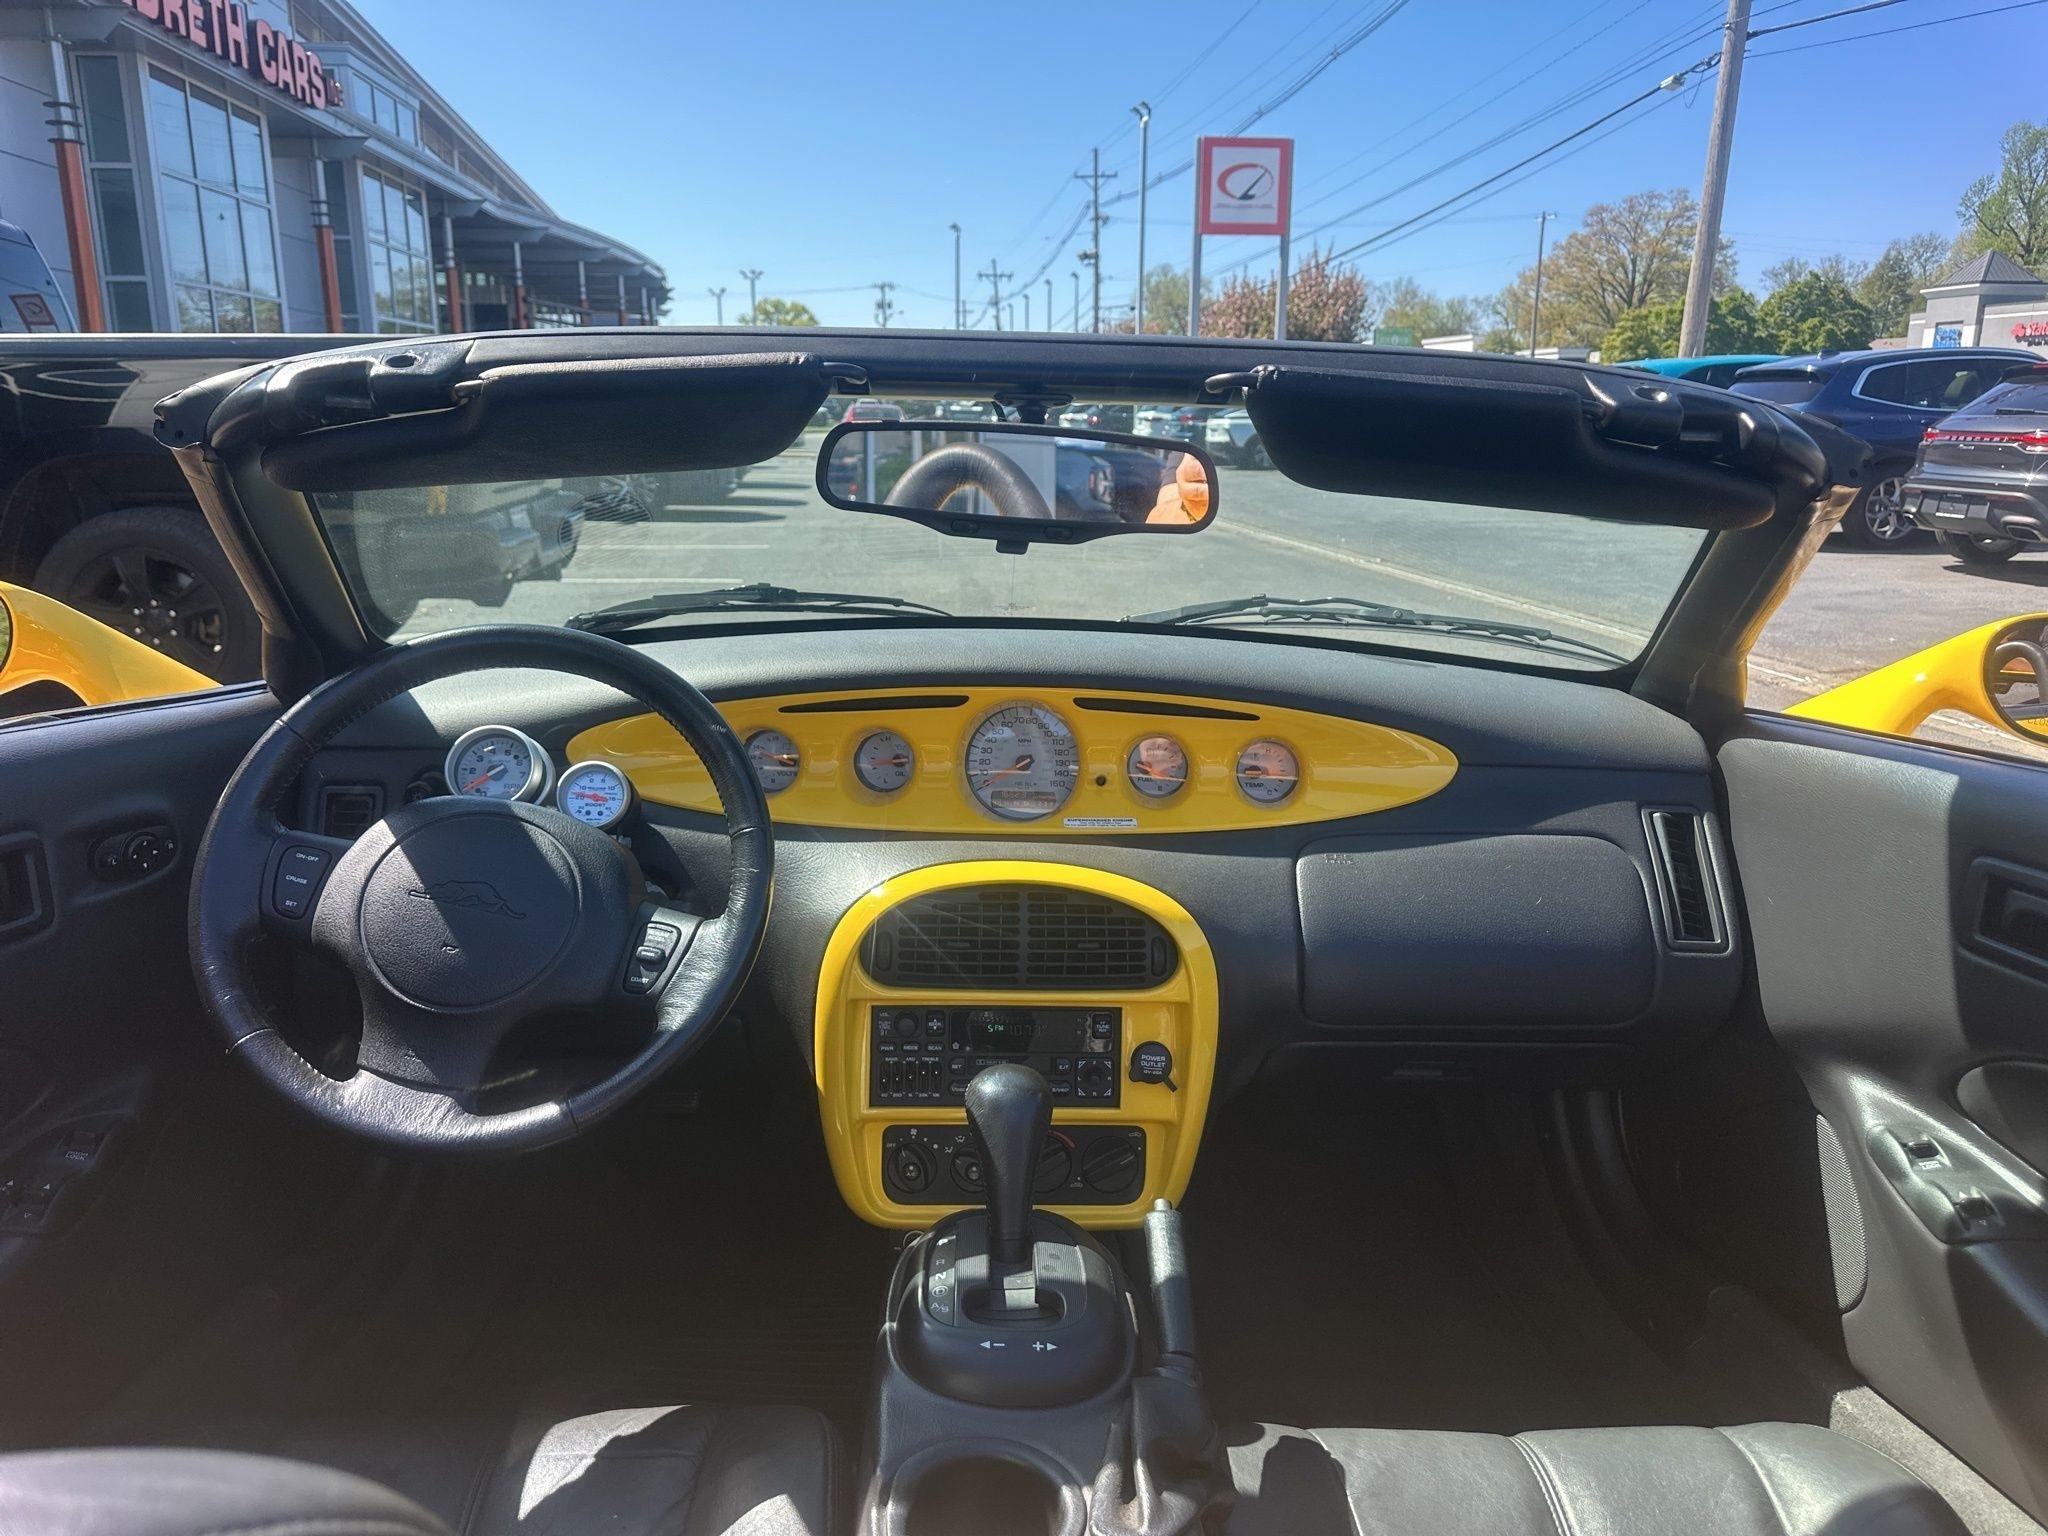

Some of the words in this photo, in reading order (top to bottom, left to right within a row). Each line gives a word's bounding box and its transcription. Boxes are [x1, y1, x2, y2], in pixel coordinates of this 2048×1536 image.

[256, 19, 326, 110] CARS
[980, 746, 993, 755] 30
[1055, 759, 1071, 767] 130
[1054, 769, 1070, 778] 140
[1050, 779, 1066, 788] 150
[285, 874, 308, 884] CRUISE
[1140, 1060, 1166, 1068] OUTLET
